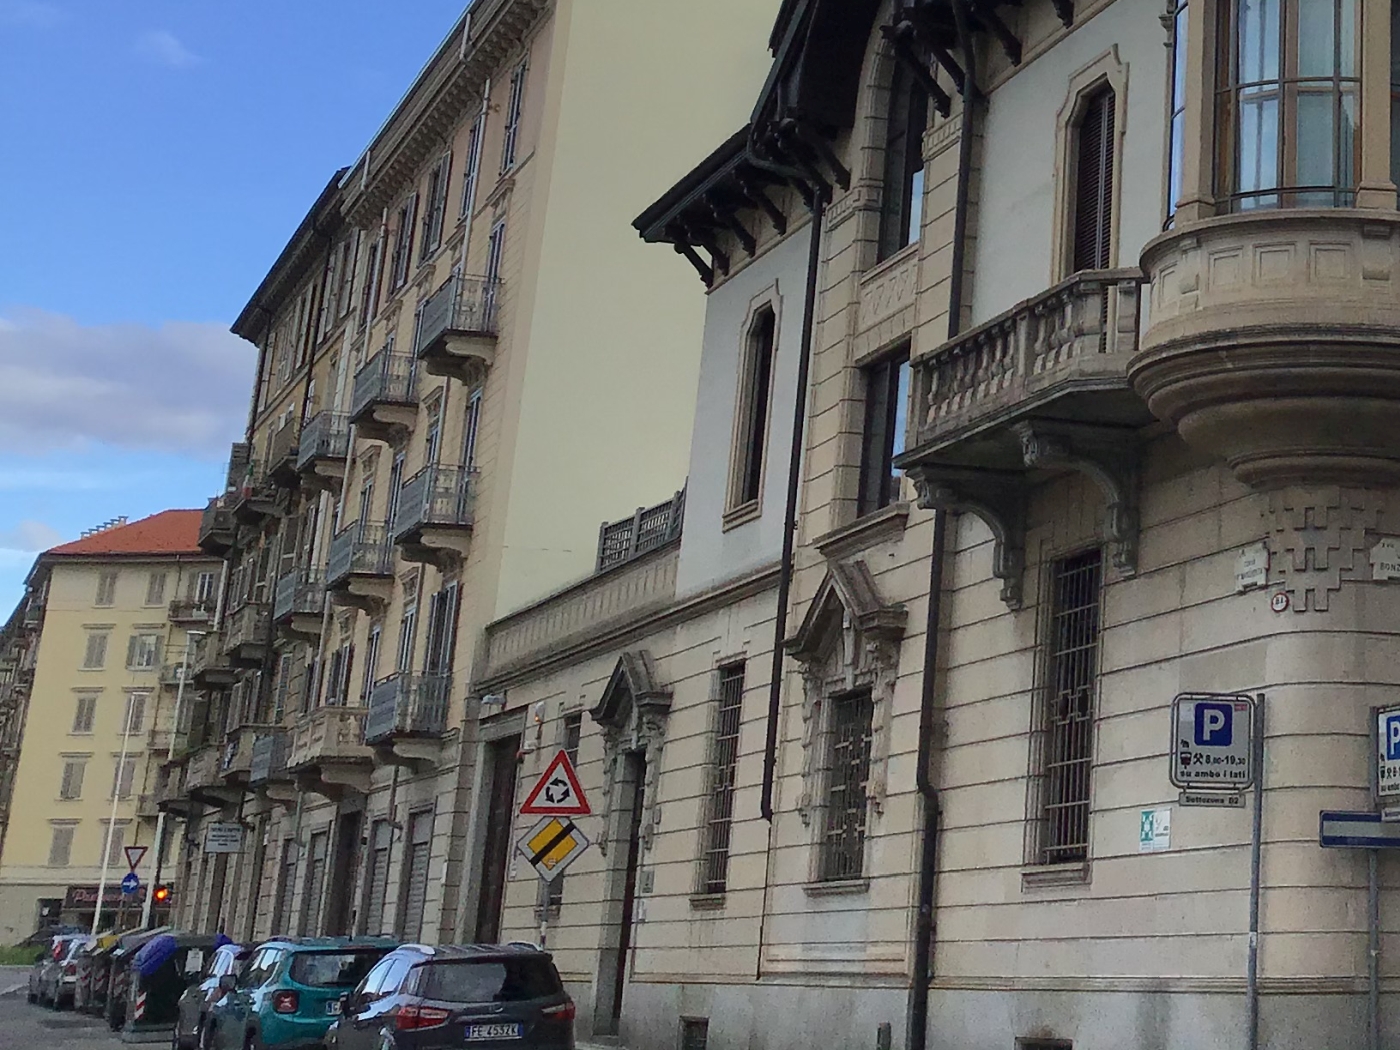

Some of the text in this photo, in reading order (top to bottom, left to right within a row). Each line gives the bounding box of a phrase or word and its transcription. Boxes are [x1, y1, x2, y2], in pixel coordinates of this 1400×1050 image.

[1202, 708, 1225, 741] P
[1194, 770, 1221, 778] ambo
[1230, 770, 1246, 778] lati
